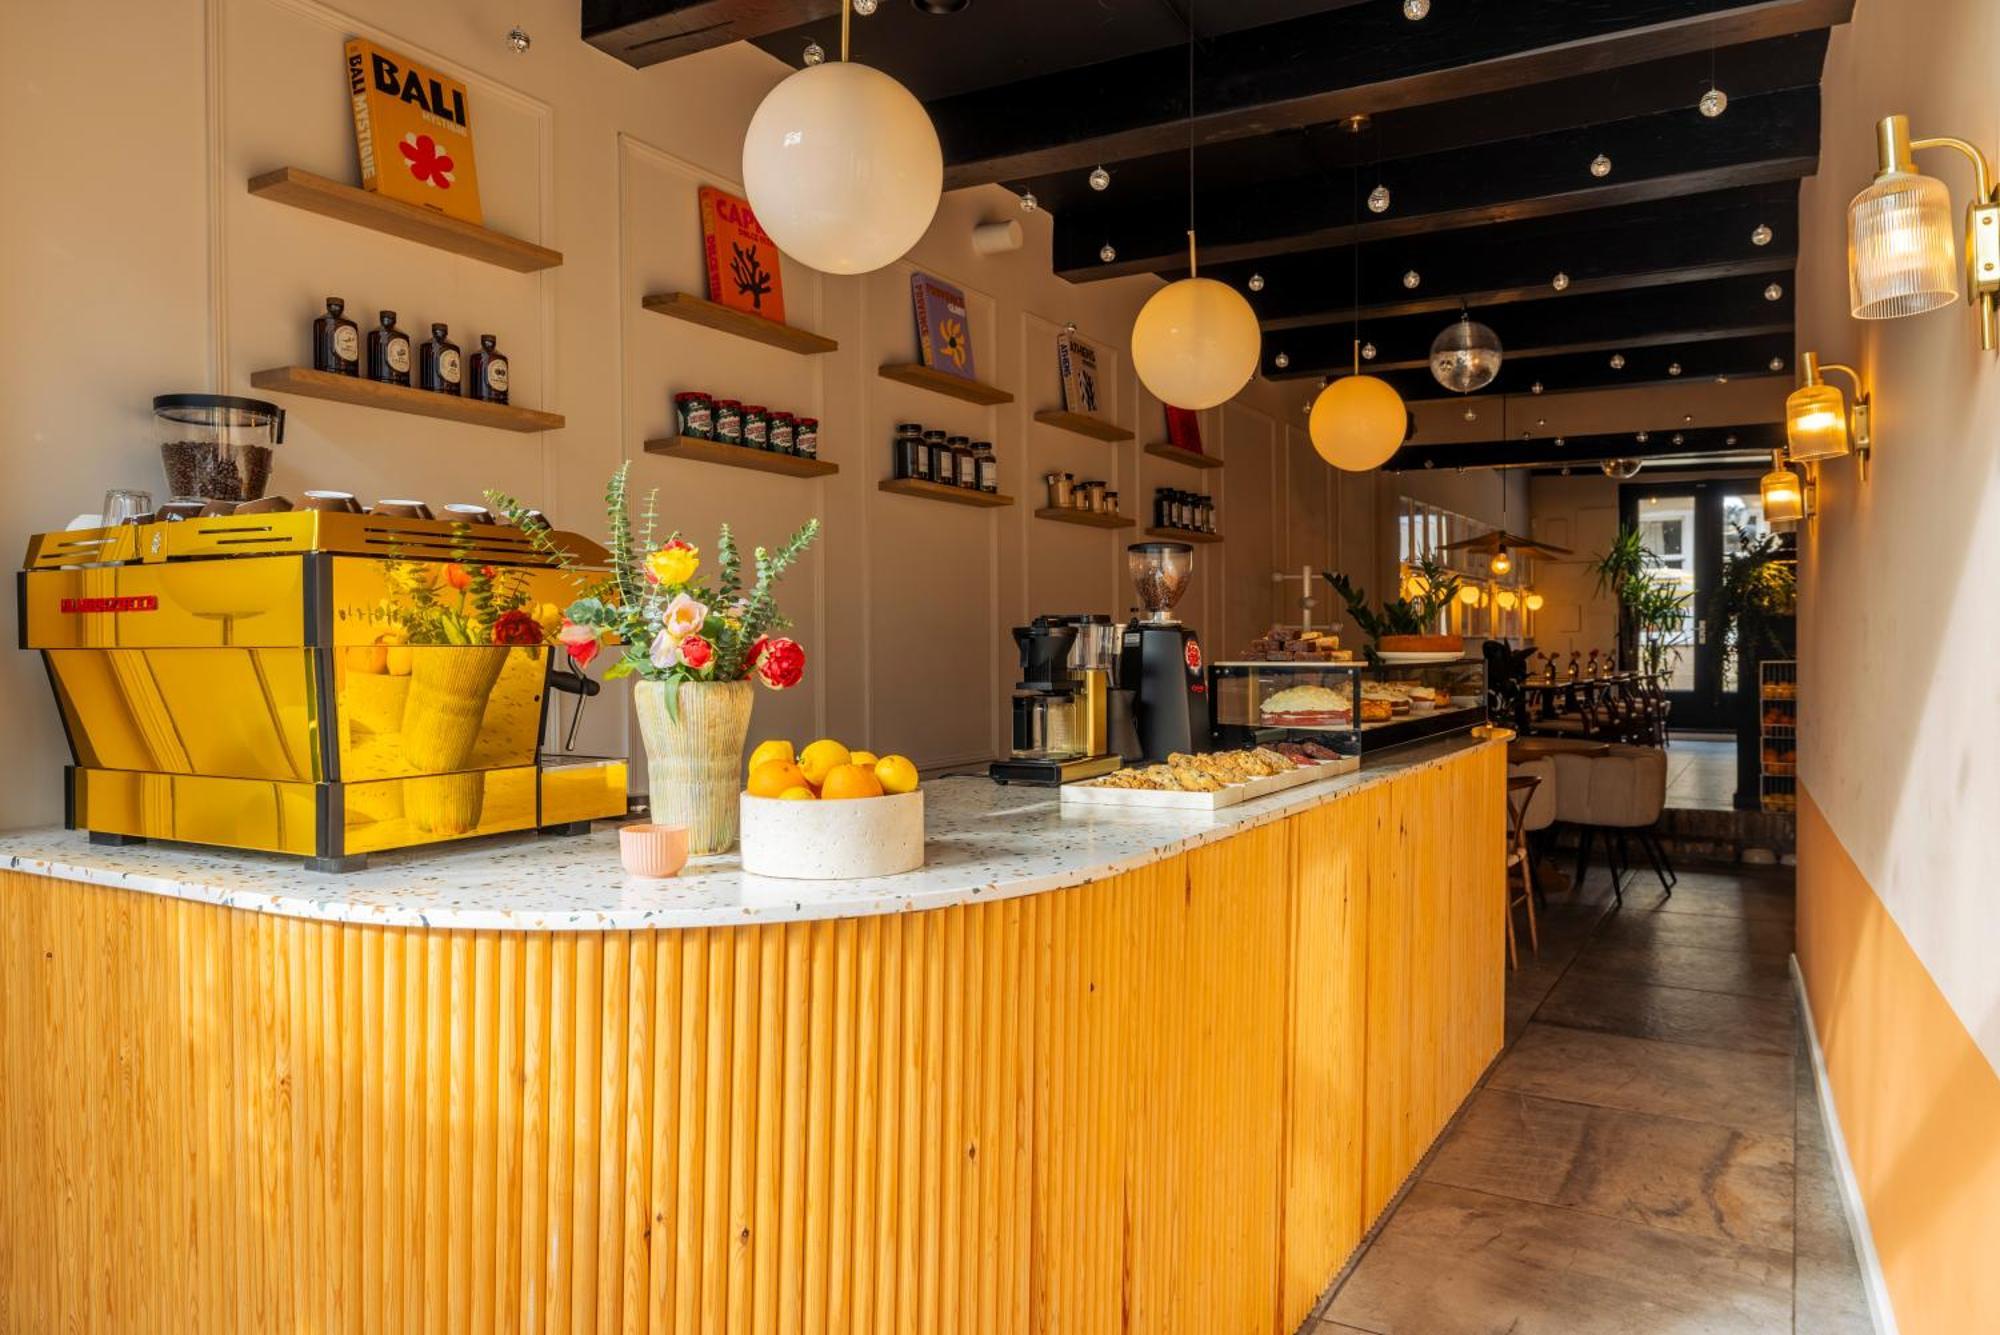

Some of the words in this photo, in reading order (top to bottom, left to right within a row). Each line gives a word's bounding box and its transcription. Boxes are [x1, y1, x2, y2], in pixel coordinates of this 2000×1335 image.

[349, 54, 366, 95] BALI
[372, 53, 466, 127] BALI
[352, 95, 376, 179] MYSTIQUE
